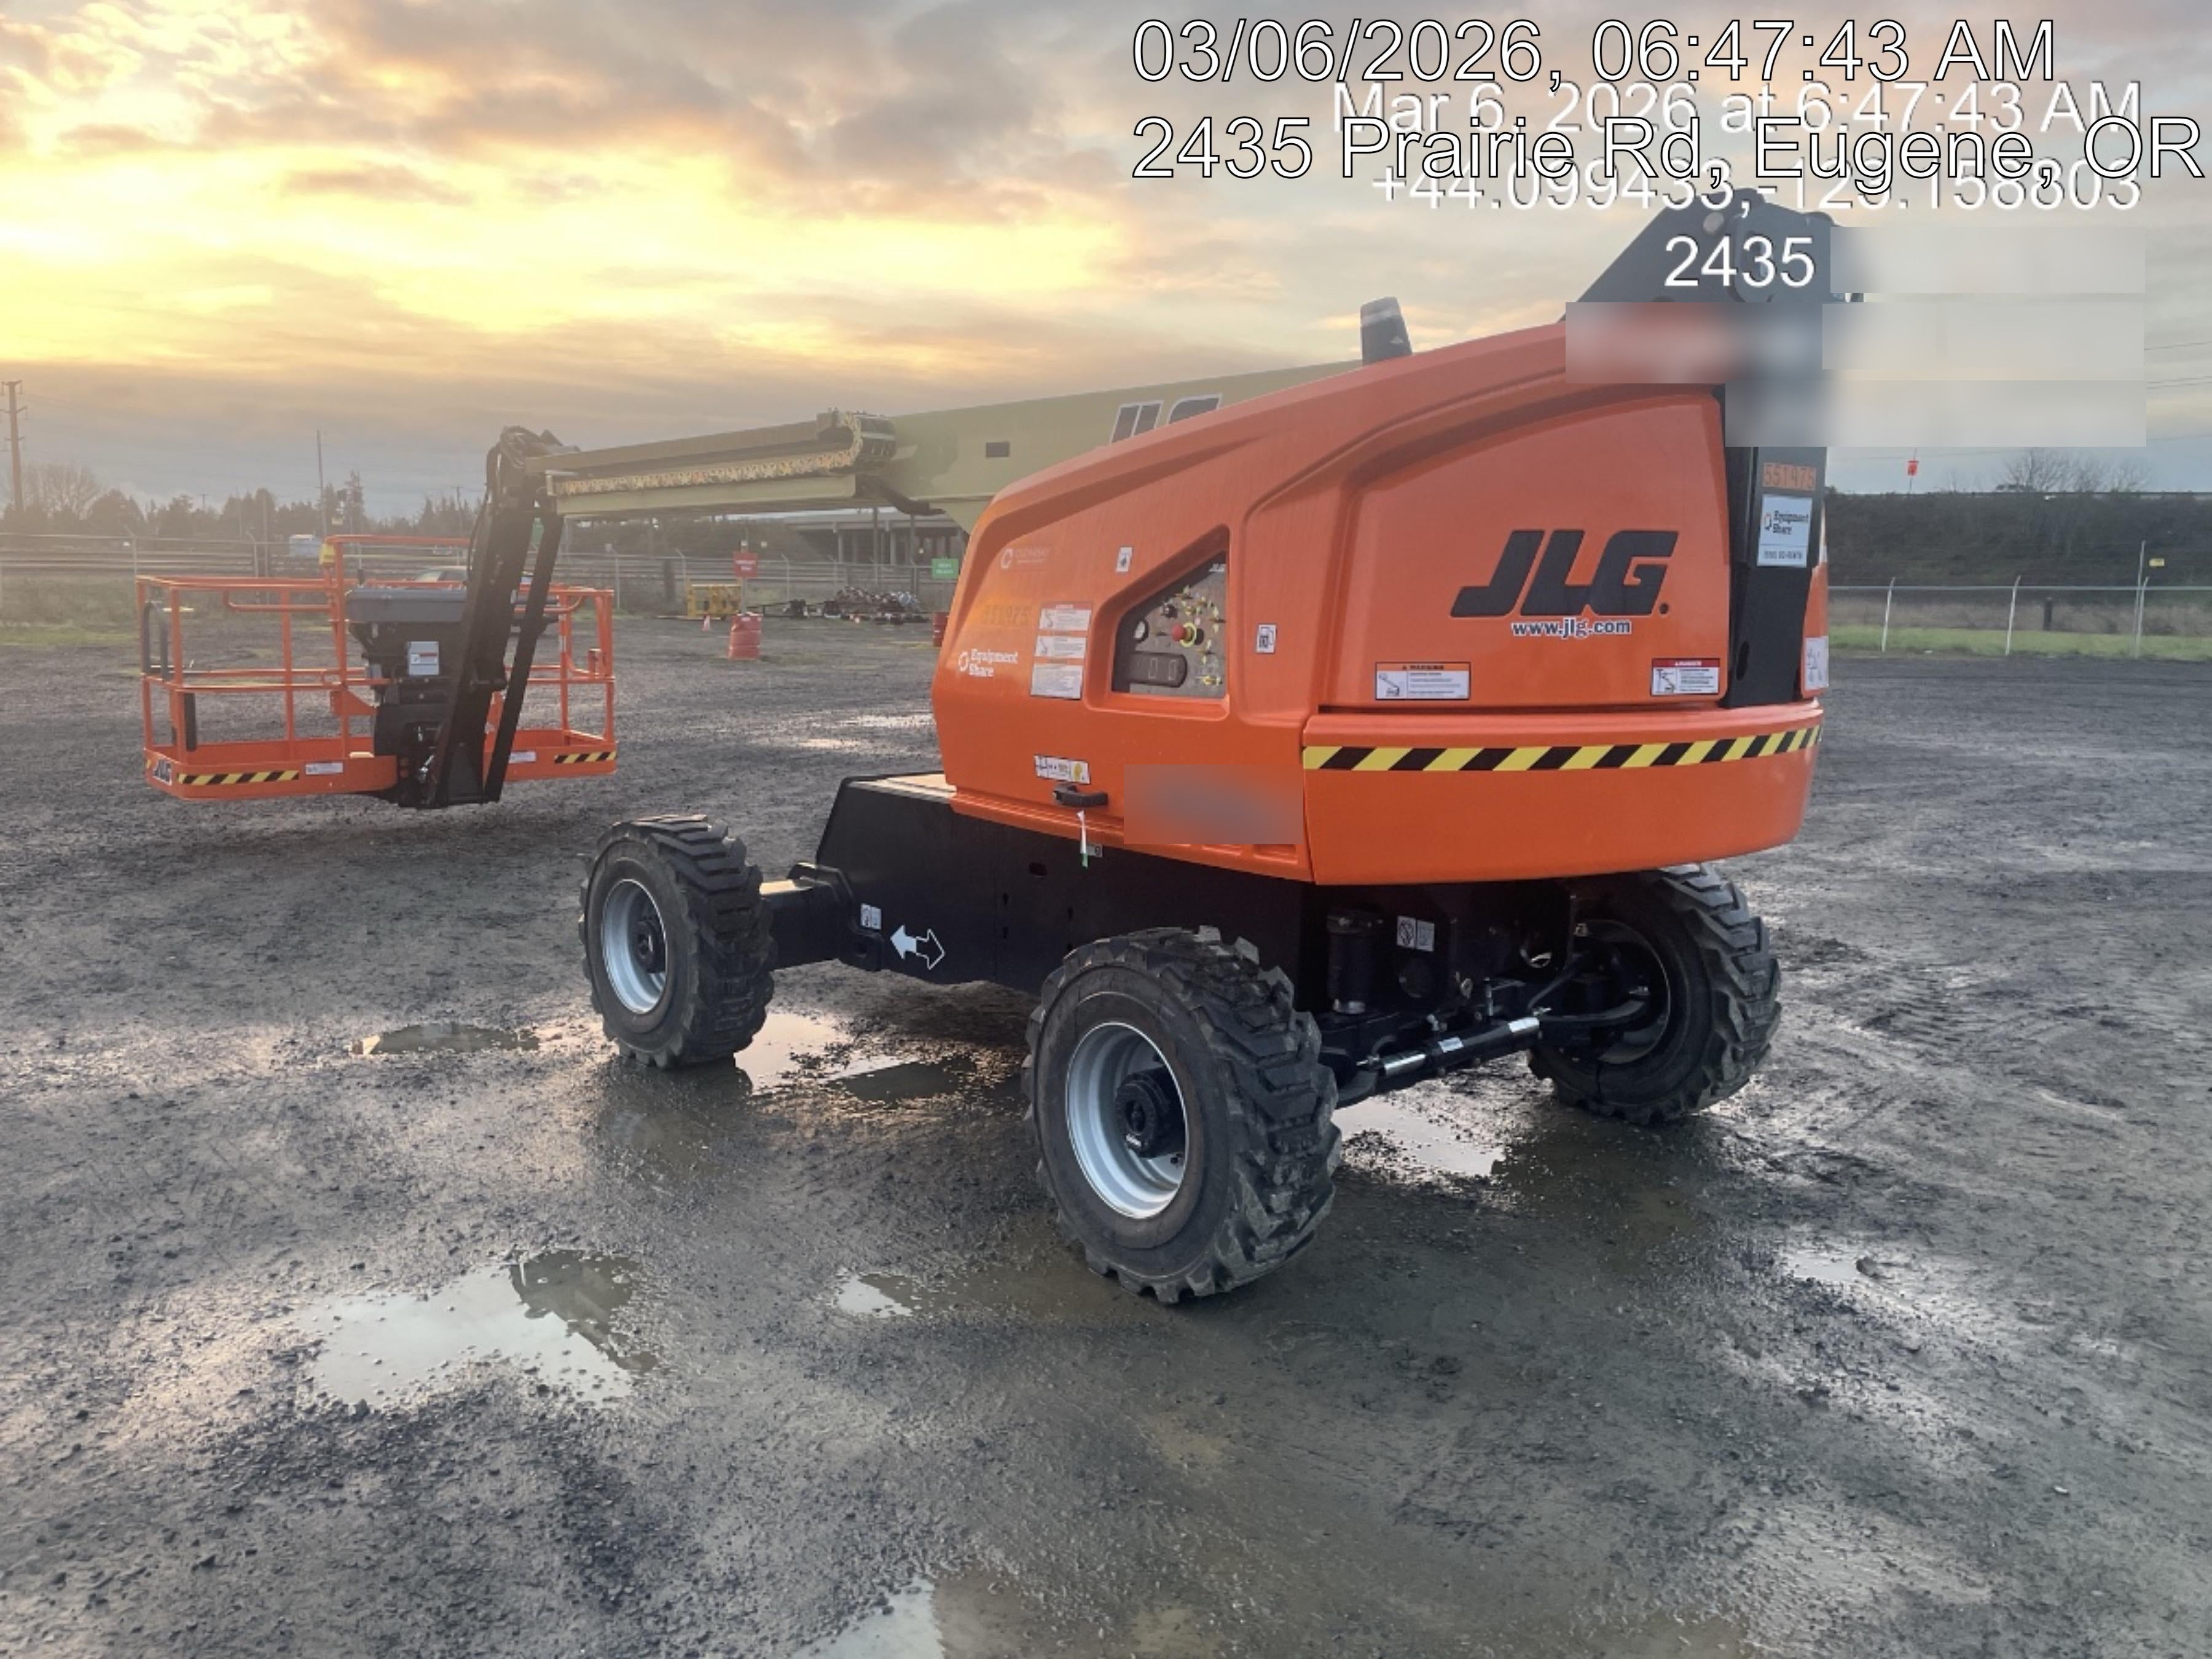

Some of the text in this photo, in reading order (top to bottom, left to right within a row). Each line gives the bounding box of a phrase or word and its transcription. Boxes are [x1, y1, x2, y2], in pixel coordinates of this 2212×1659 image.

[1512, 618, 1632, 638] www.jlg.com
[971, 648, 1018, 664] Equipment
[968, 664, 994, 677] Share
